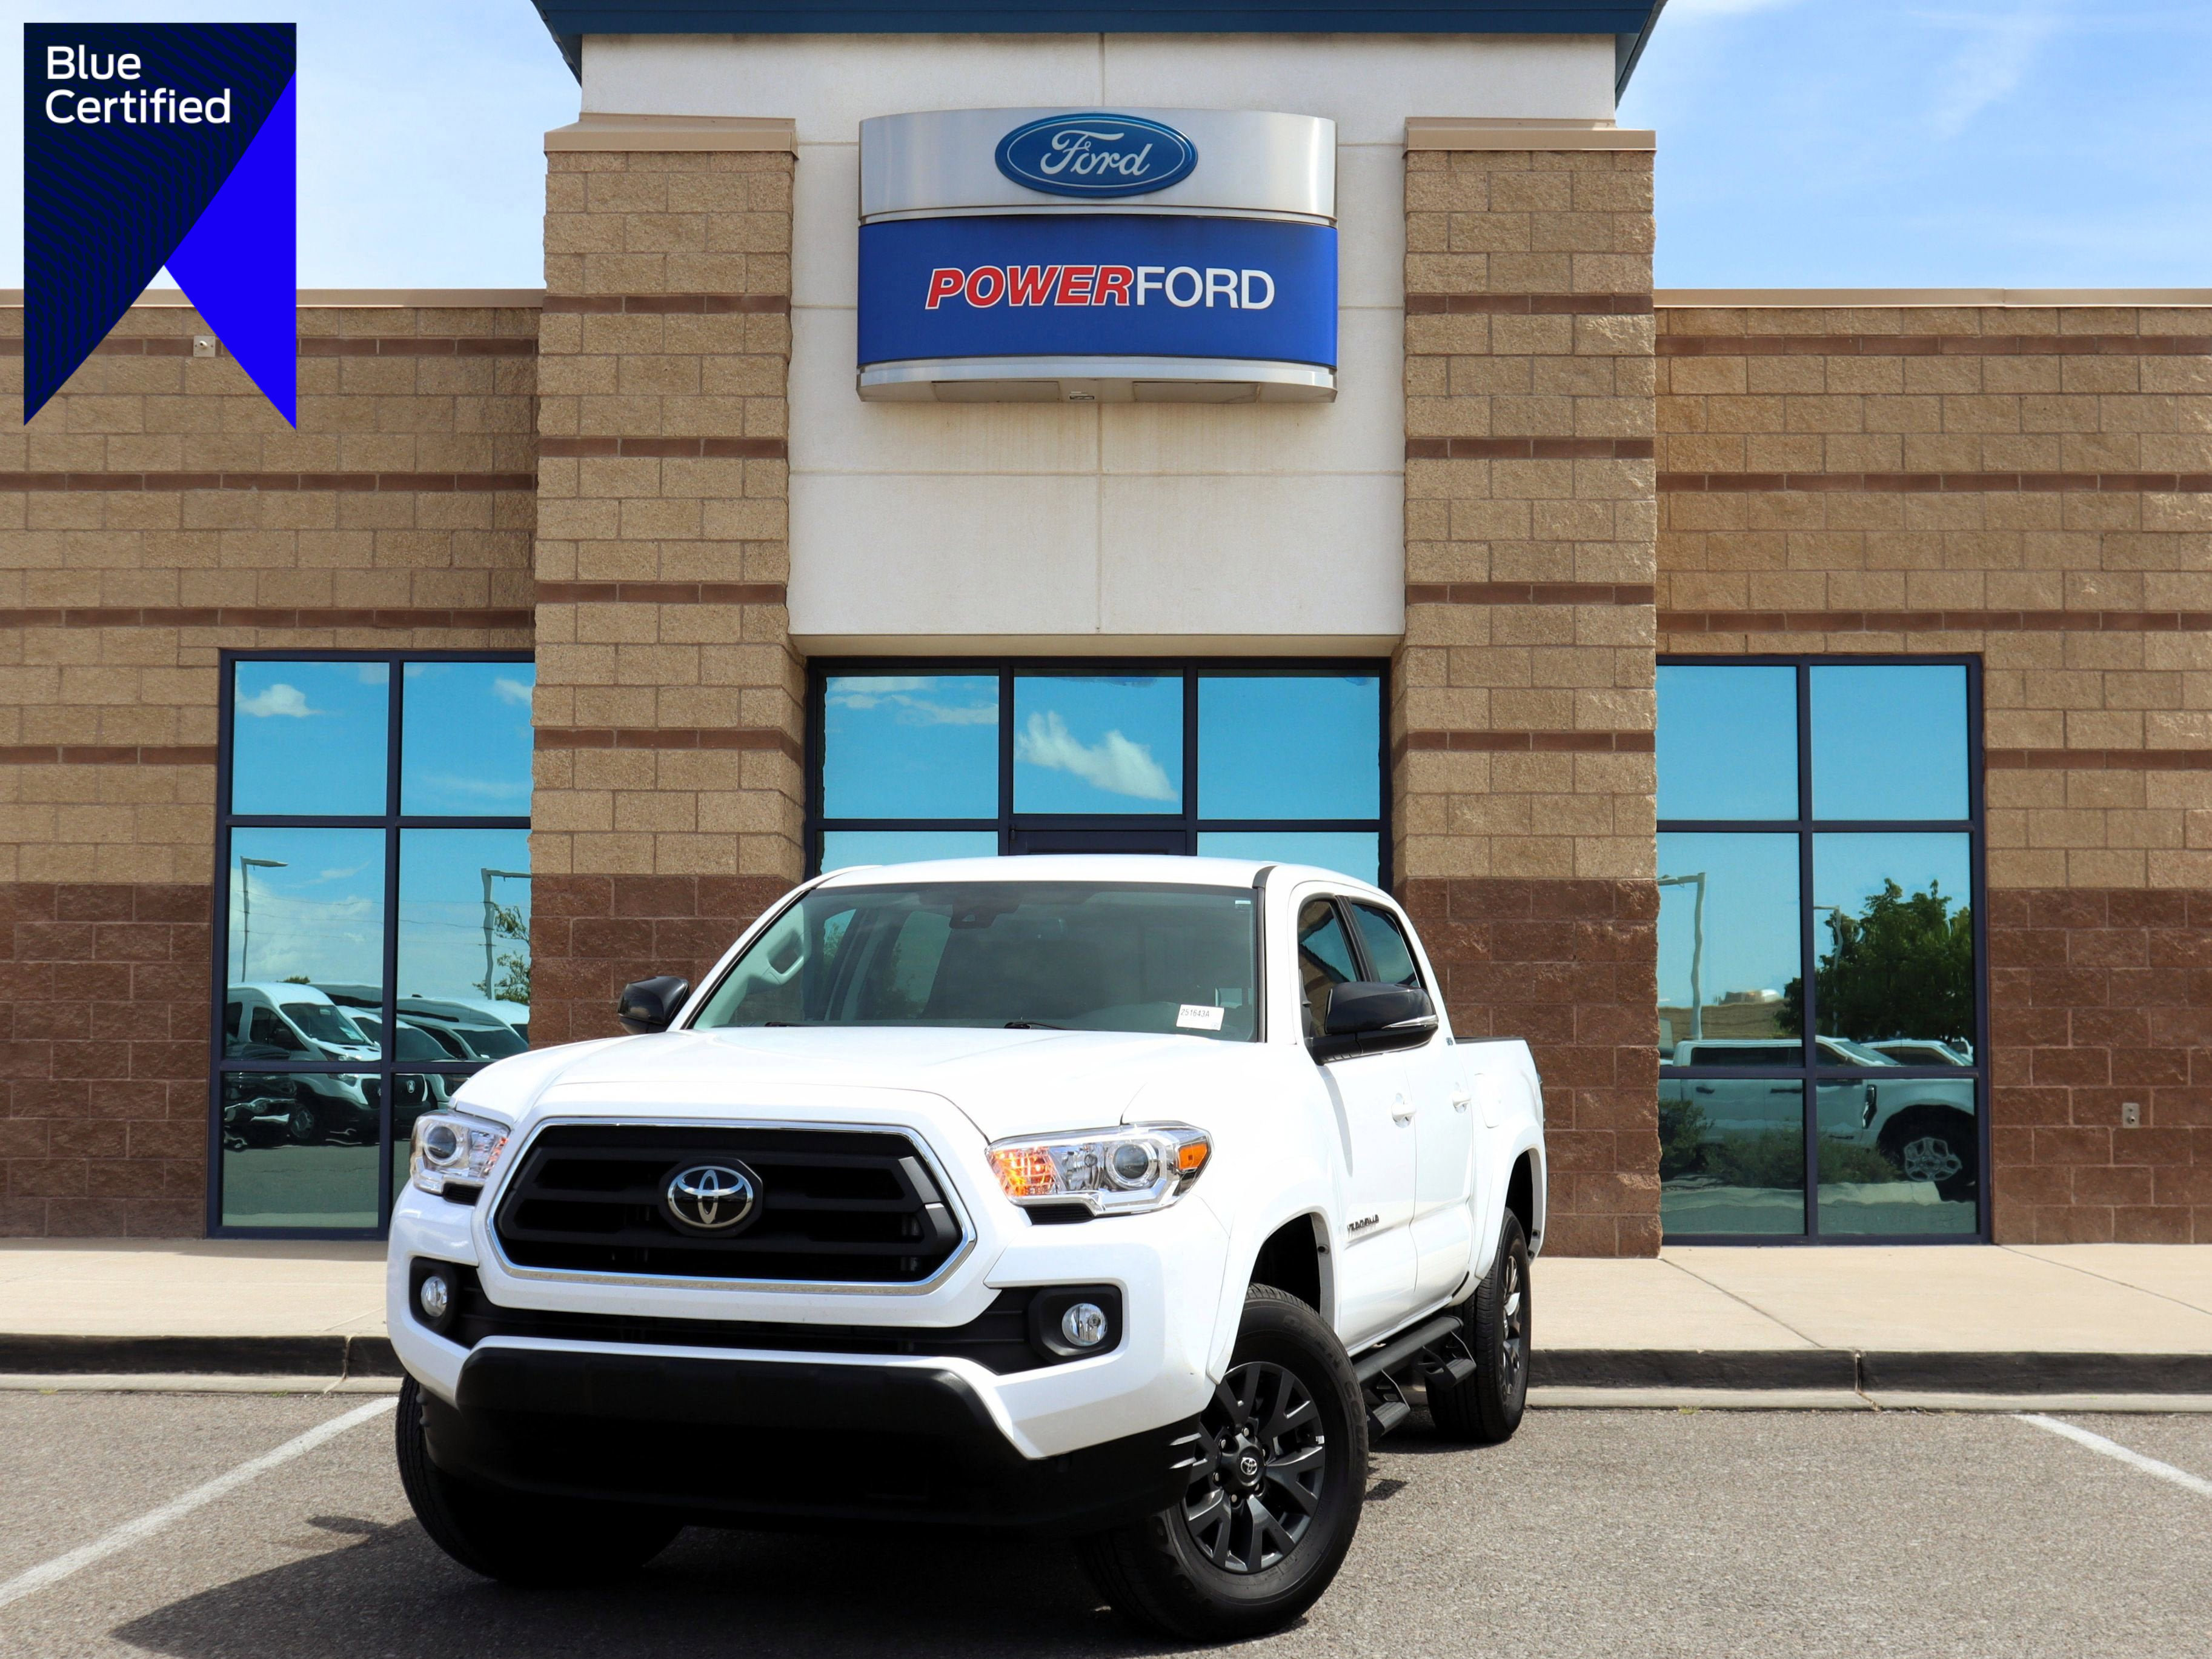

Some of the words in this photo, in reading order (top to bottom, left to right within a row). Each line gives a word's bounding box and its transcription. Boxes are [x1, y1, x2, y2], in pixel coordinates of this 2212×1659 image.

[1039, 129, 1152, 176] Ford
[925, 265, 1275, 310] POWERFORD
[1180, 1008, 1209, 1017] 251643A
